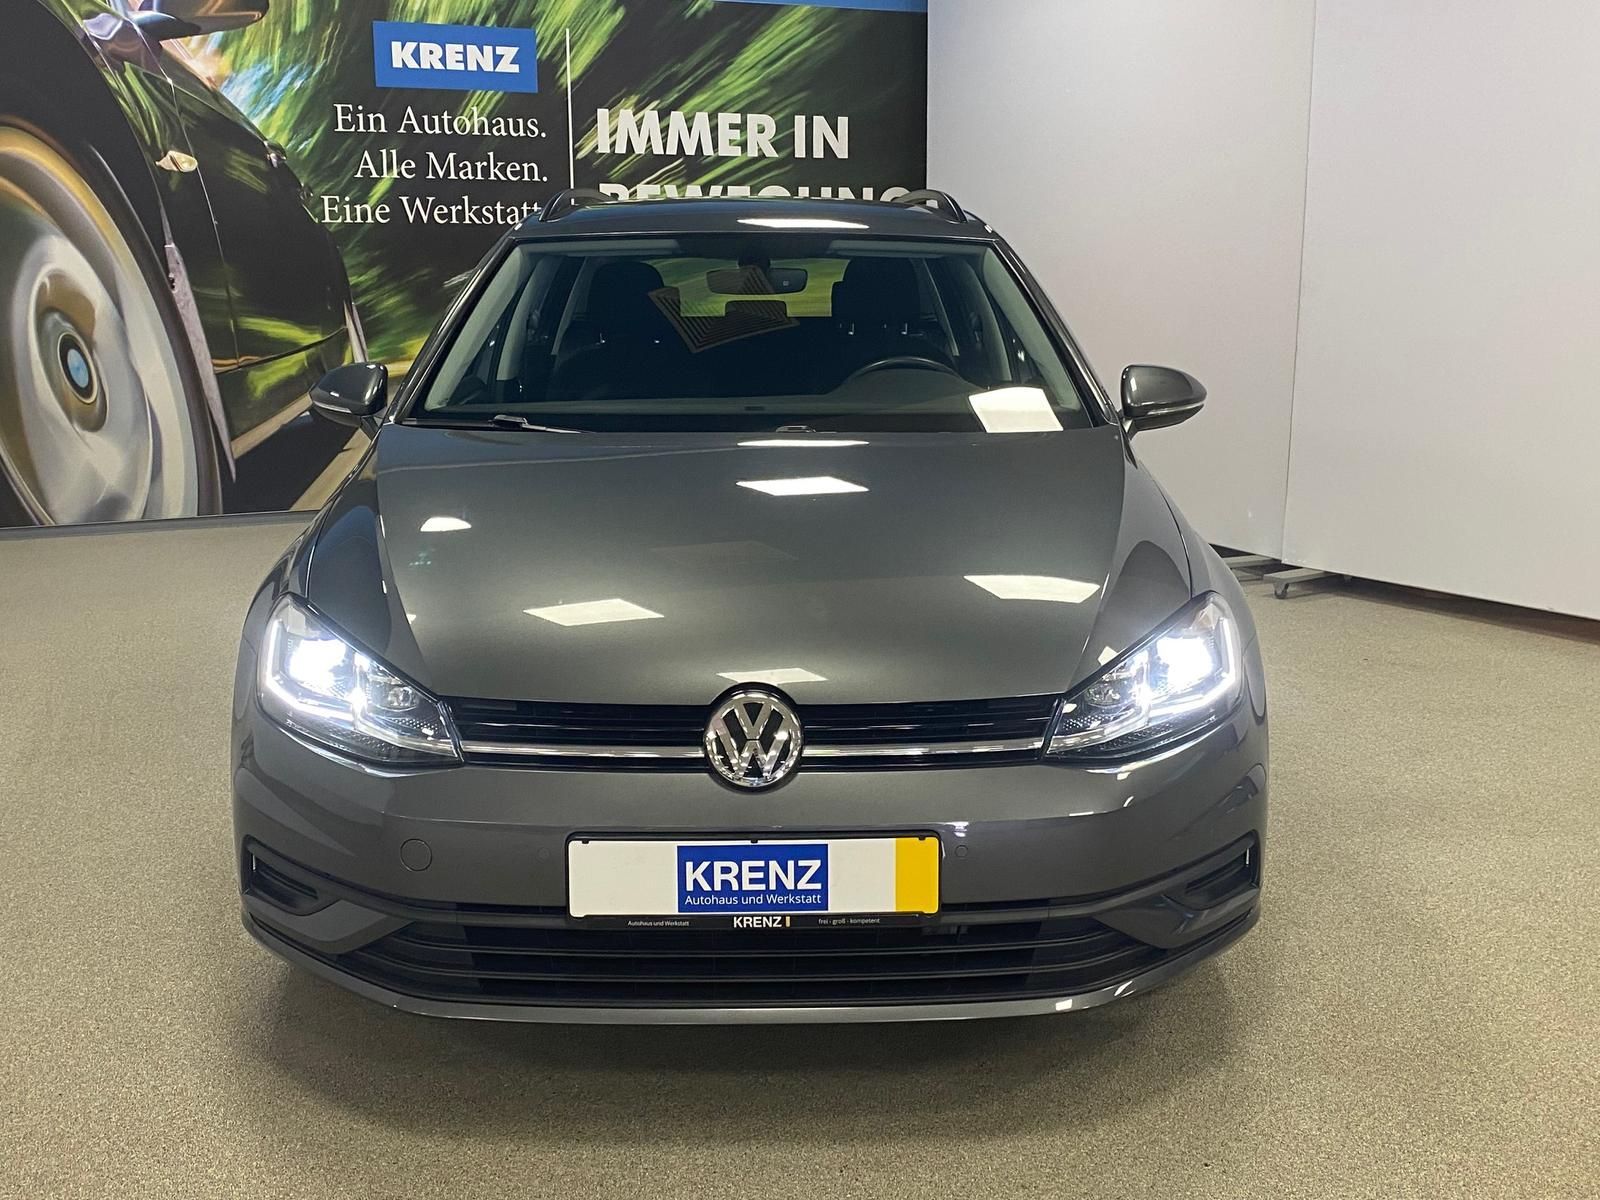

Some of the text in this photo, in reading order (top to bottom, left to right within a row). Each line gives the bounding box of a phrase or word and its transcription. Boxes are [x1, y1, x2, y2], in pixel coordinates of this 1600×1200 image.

[391, 41, 520, 73] KRENZ
[334, 103, 547, 138] Ein Autohaus.
[597, 108, 849, 159] IMMER IN
[354, 149, 548, 183] Alle Marken.
[321, 195, 390, 224] Eine
[685, 860, 822, 891] KRENZ
[684, 894, 821, 905] Autohaus und Werkstatt
[733, 917, 782, 928] KRENZ
